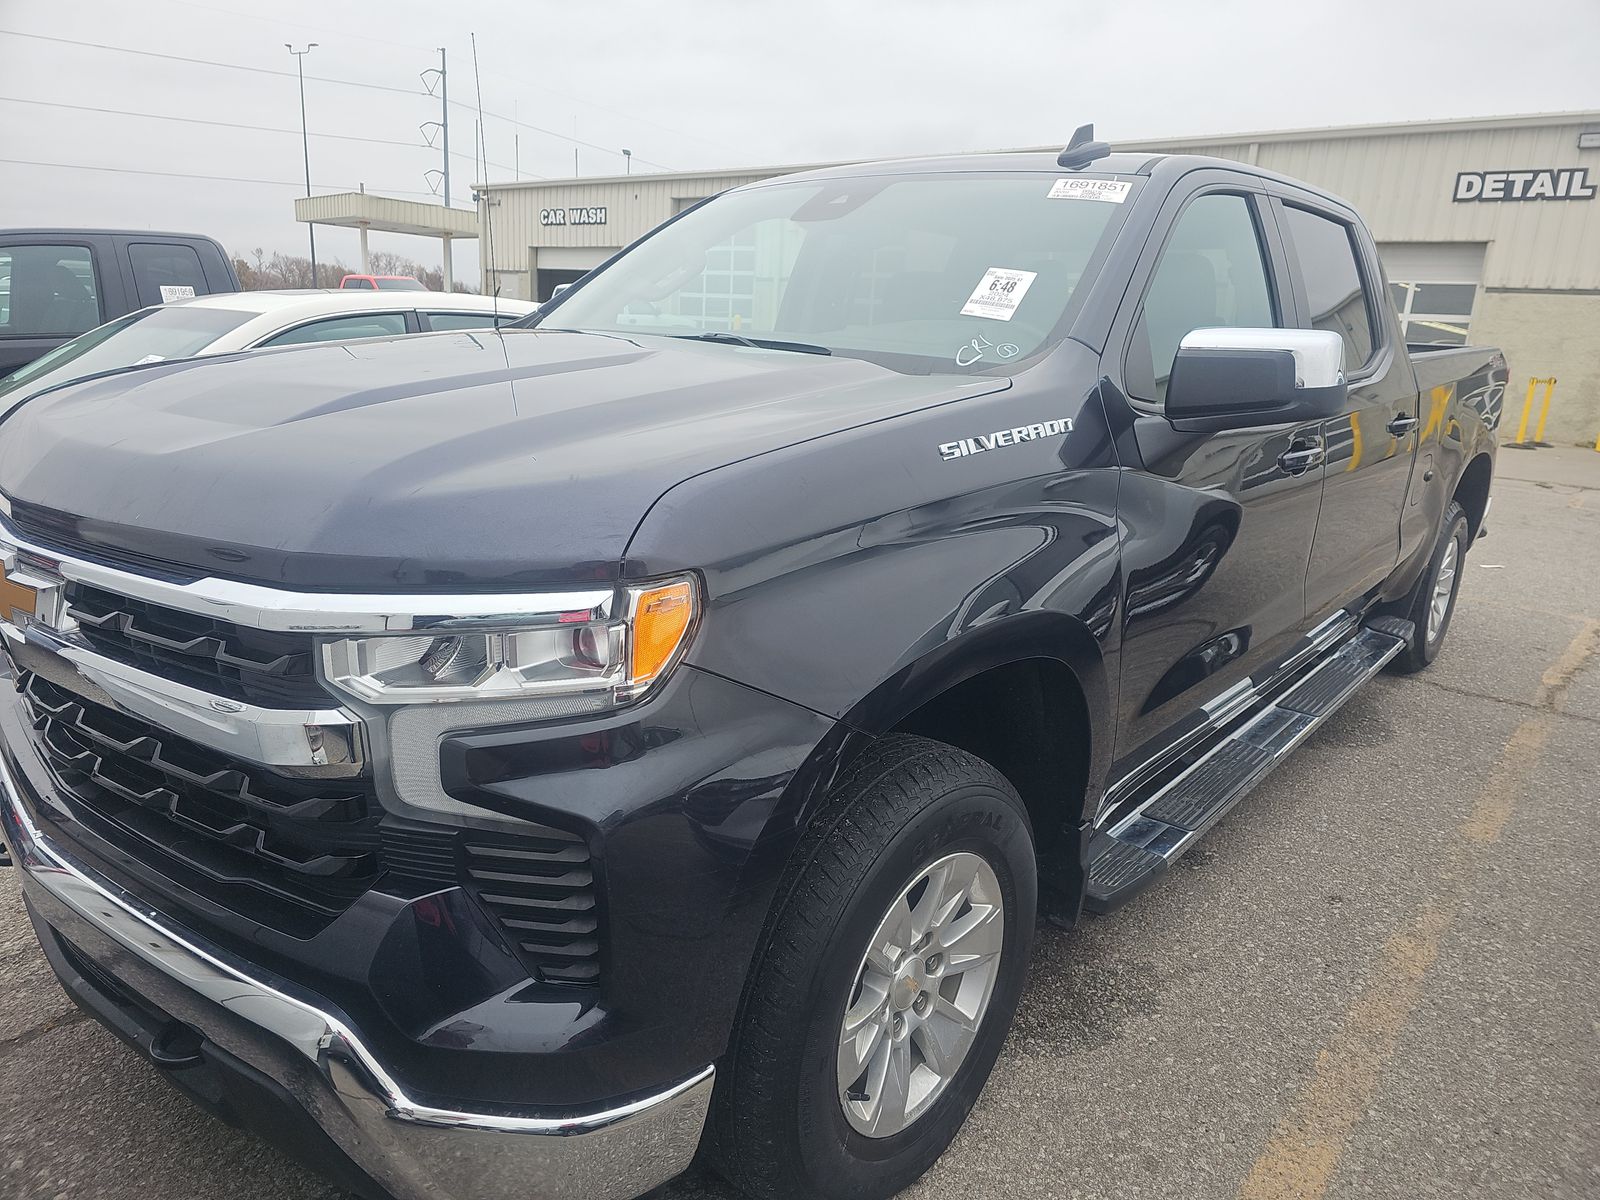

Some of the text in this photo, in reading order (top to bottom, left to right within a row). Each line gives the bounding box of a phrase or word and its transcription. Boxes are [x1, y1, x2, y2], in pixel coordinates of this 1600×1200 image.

[1061, 180, 1126, 192] 1691851
[1453, 168, 1597, 202] DETAIL
[540, 206, 607, 226] CAR WASH
[989, 279, 1017, 293] 6:48
[938, 418, 1074, 461] SILVERADO
